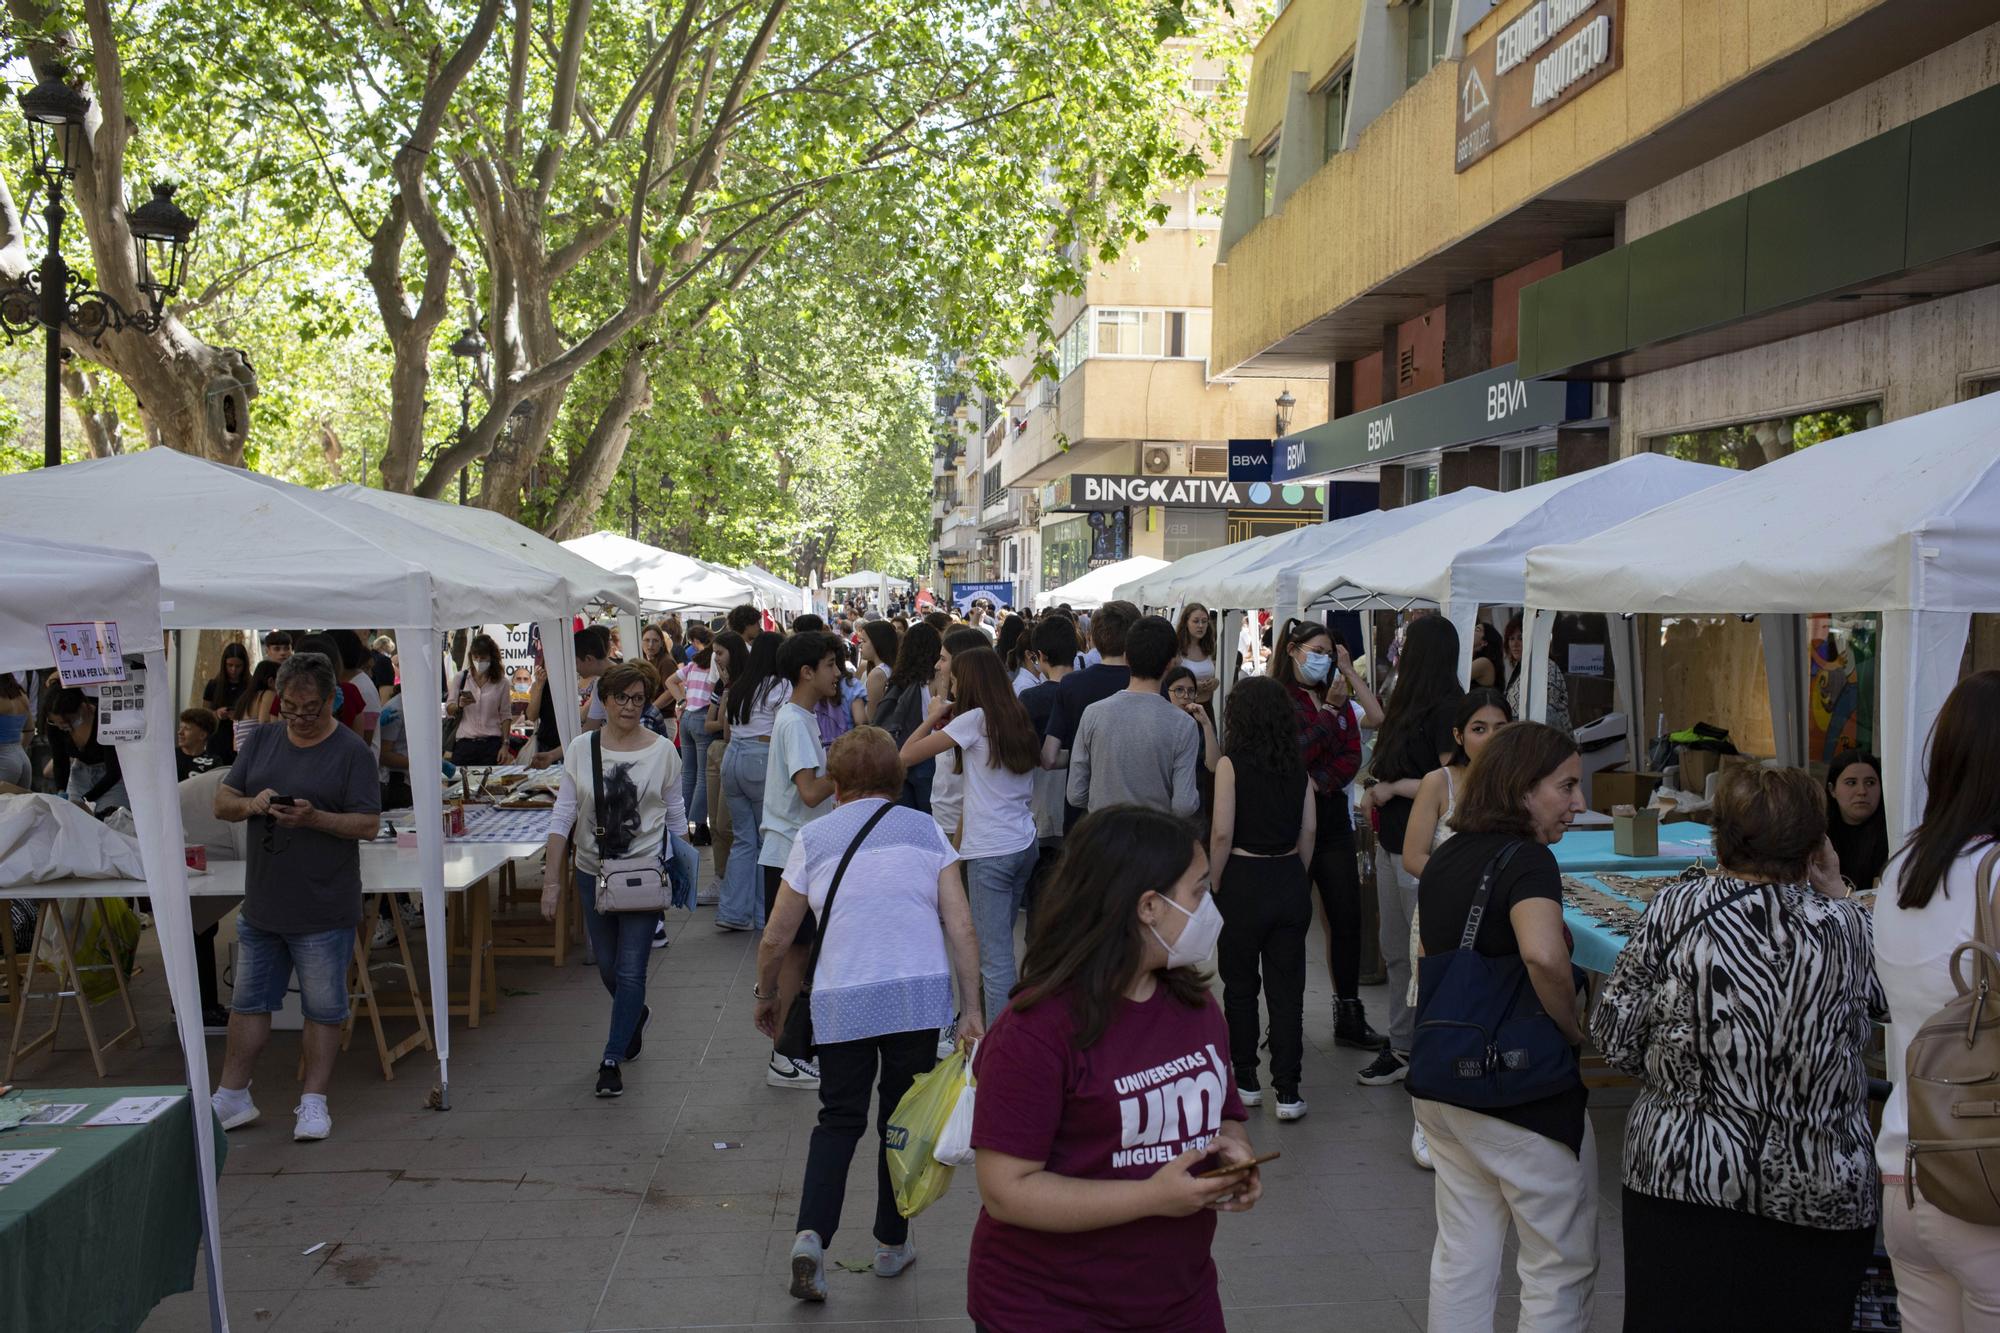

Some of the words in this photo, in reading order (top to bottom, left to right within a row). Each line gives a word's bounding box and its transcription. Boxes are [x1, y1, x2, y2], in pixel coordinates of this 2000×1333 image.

[1496, 0, 1549, 76] EZEQUIEL
[1531, 15, 1609, 108] ARQUITECTO
[1487, 379, 1528, 422] BBVA
[1368, 413, 1394, 451] BBVA
[1232, 454, 1268, 466] BBVA
[1287, 439, 1306, 471] BBVA
[506, 632, 527, 642] TOT
[1114, 1051, 1207, 1095] UNIVERSITAS
[1458, 1061, 1481, 1069] CARA
[1459, 1069, 1482, 1077] MELO
[1112, 1145, 1177, 1168] MIGUEL
